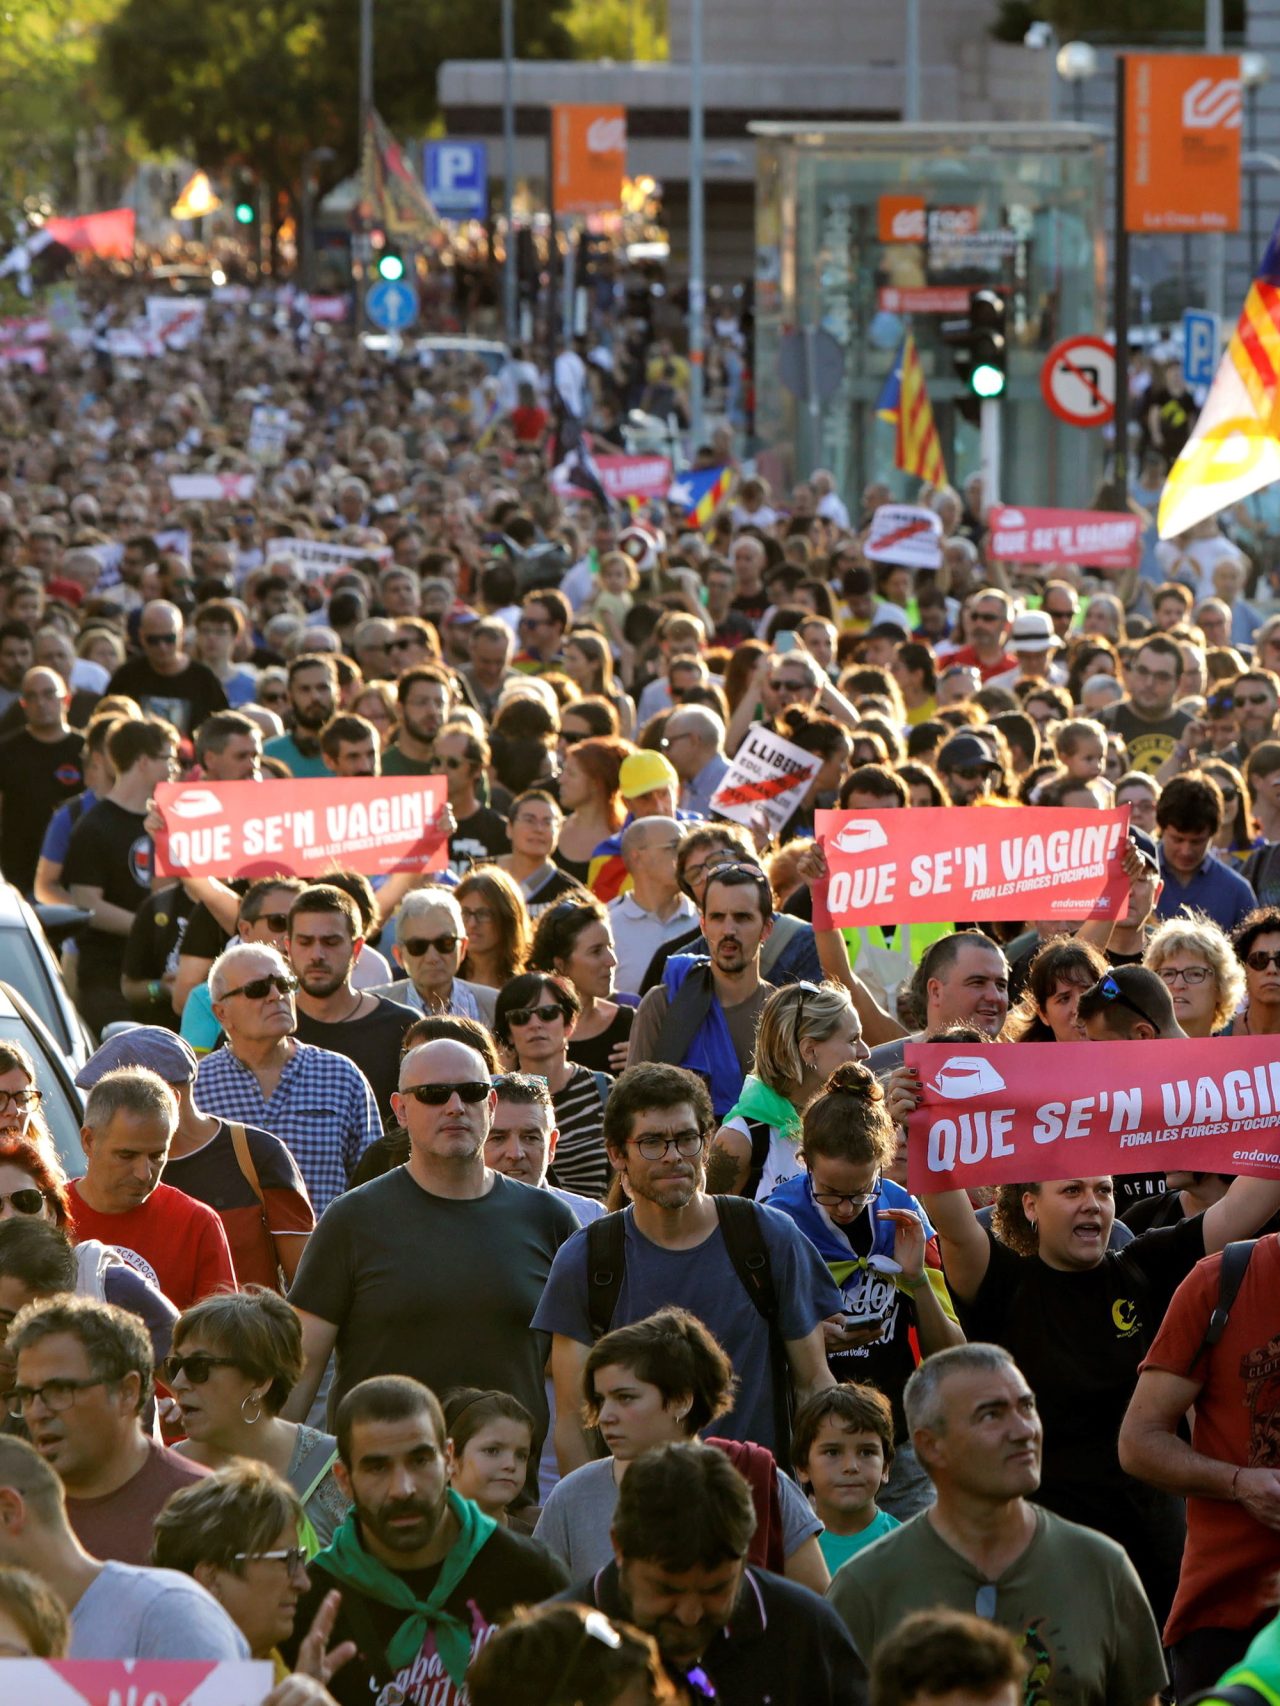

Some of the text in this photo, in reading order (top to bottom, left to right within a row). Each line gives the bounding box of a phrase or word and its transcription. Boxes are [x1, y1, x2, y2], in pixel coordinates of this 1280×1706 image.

[437, 147, 475, 188] P
[1191, 321, 1210, 378] P
[168, 789, 435, 868] QUE SE'N VAGIN!
[302, 846, 326, 860] FORA
[326, 844, 342, 856] LES
[825, 822, 1122, 914] QUE SE'N VAGIN!
[970, 861, 1105, 903] FORA LES FORCES D'OCUPACIÓ
[1051, 896, 1095, 909] endavant
[926, 1107, 1016, 1173] QUE
[1032, 1086, 1143, 1145] SE'N
[1119, 1131, 1153, 1149] FORA
[1154, 1128, 1179, 1143] LES
[1180, 1120, 1230, 1140] FORCES
